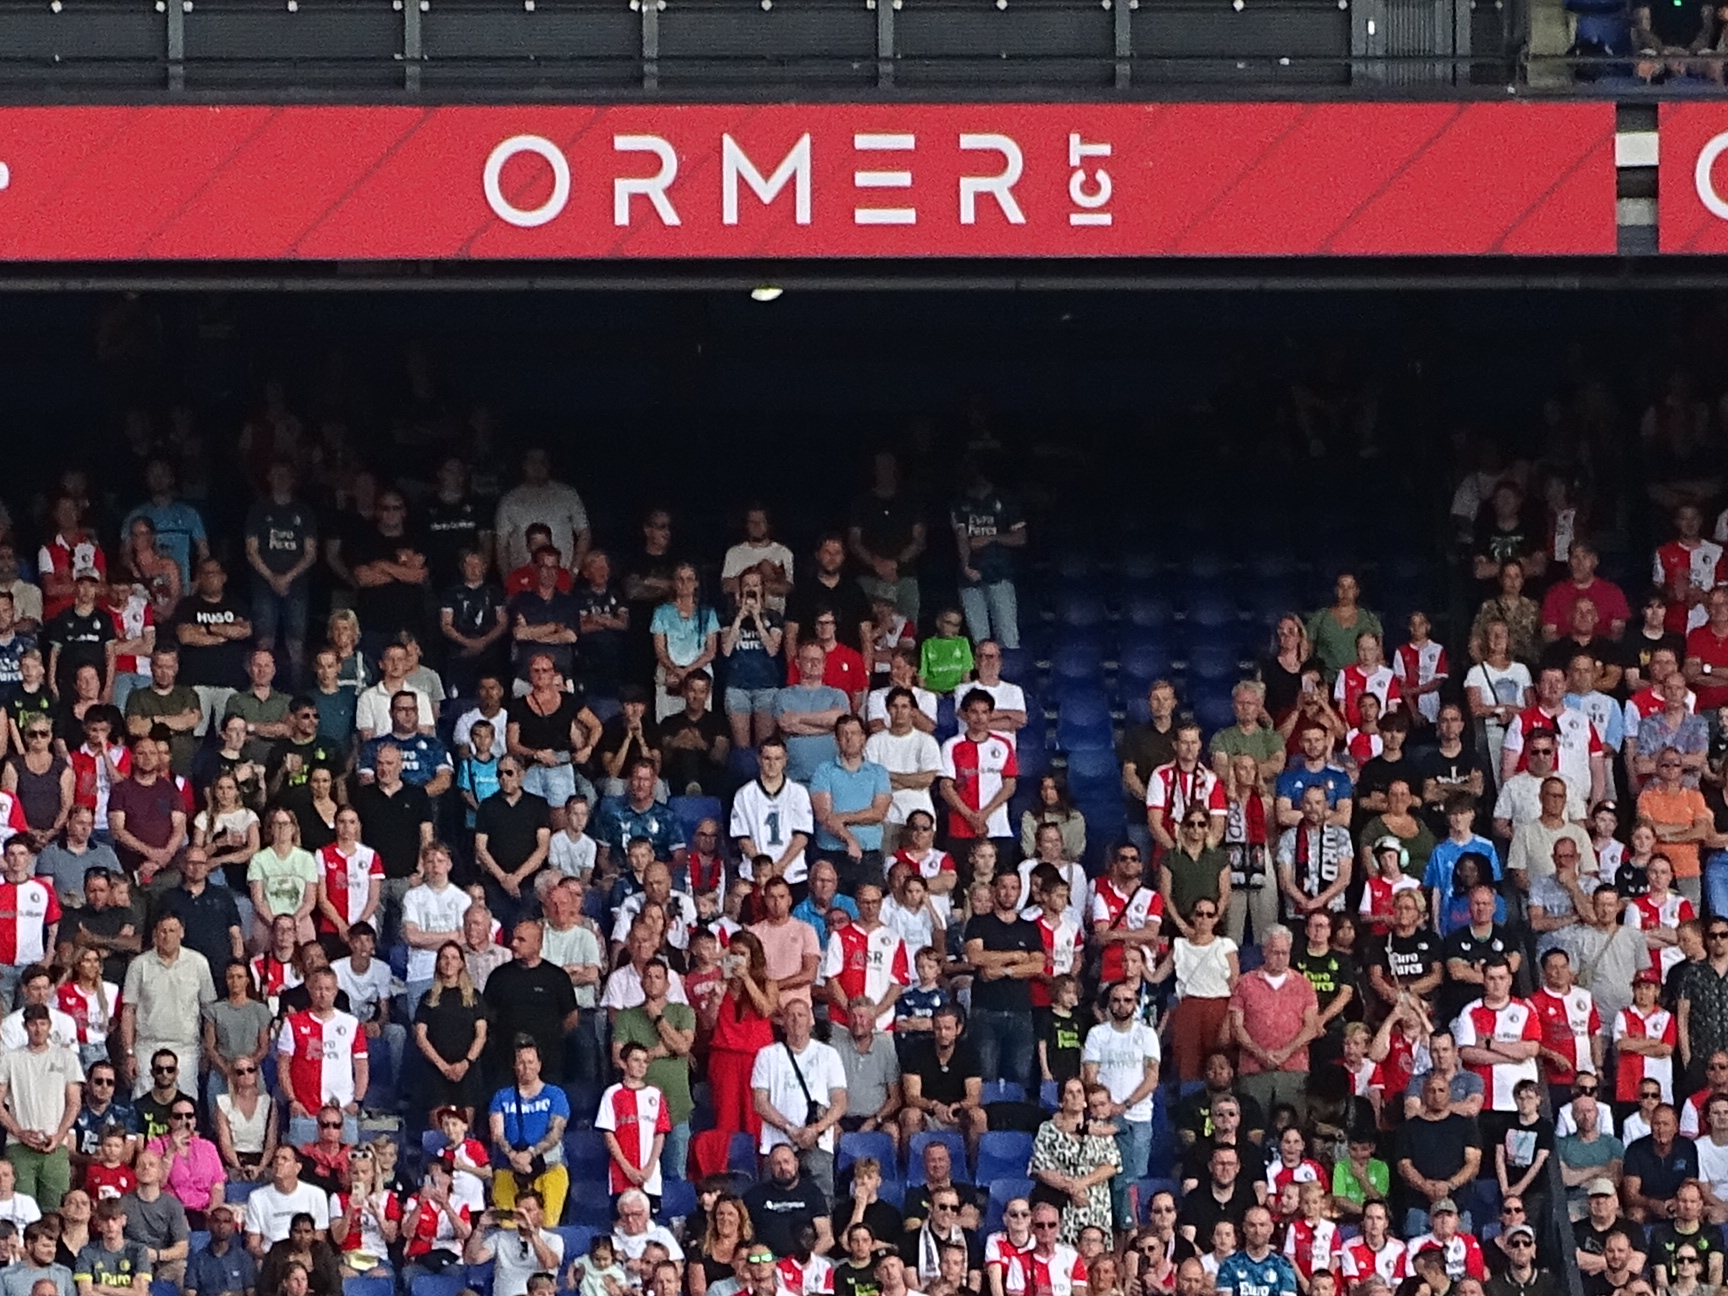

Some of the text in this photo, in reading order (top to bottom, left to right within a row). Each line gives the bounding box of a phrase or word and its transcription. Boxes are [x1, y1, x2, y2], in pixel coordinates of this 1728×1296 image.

[483, 132, 1113, 227] ORMER ICT
[196, 611, 234, 623] HUGO
[763, 811, 784, 846] 1
